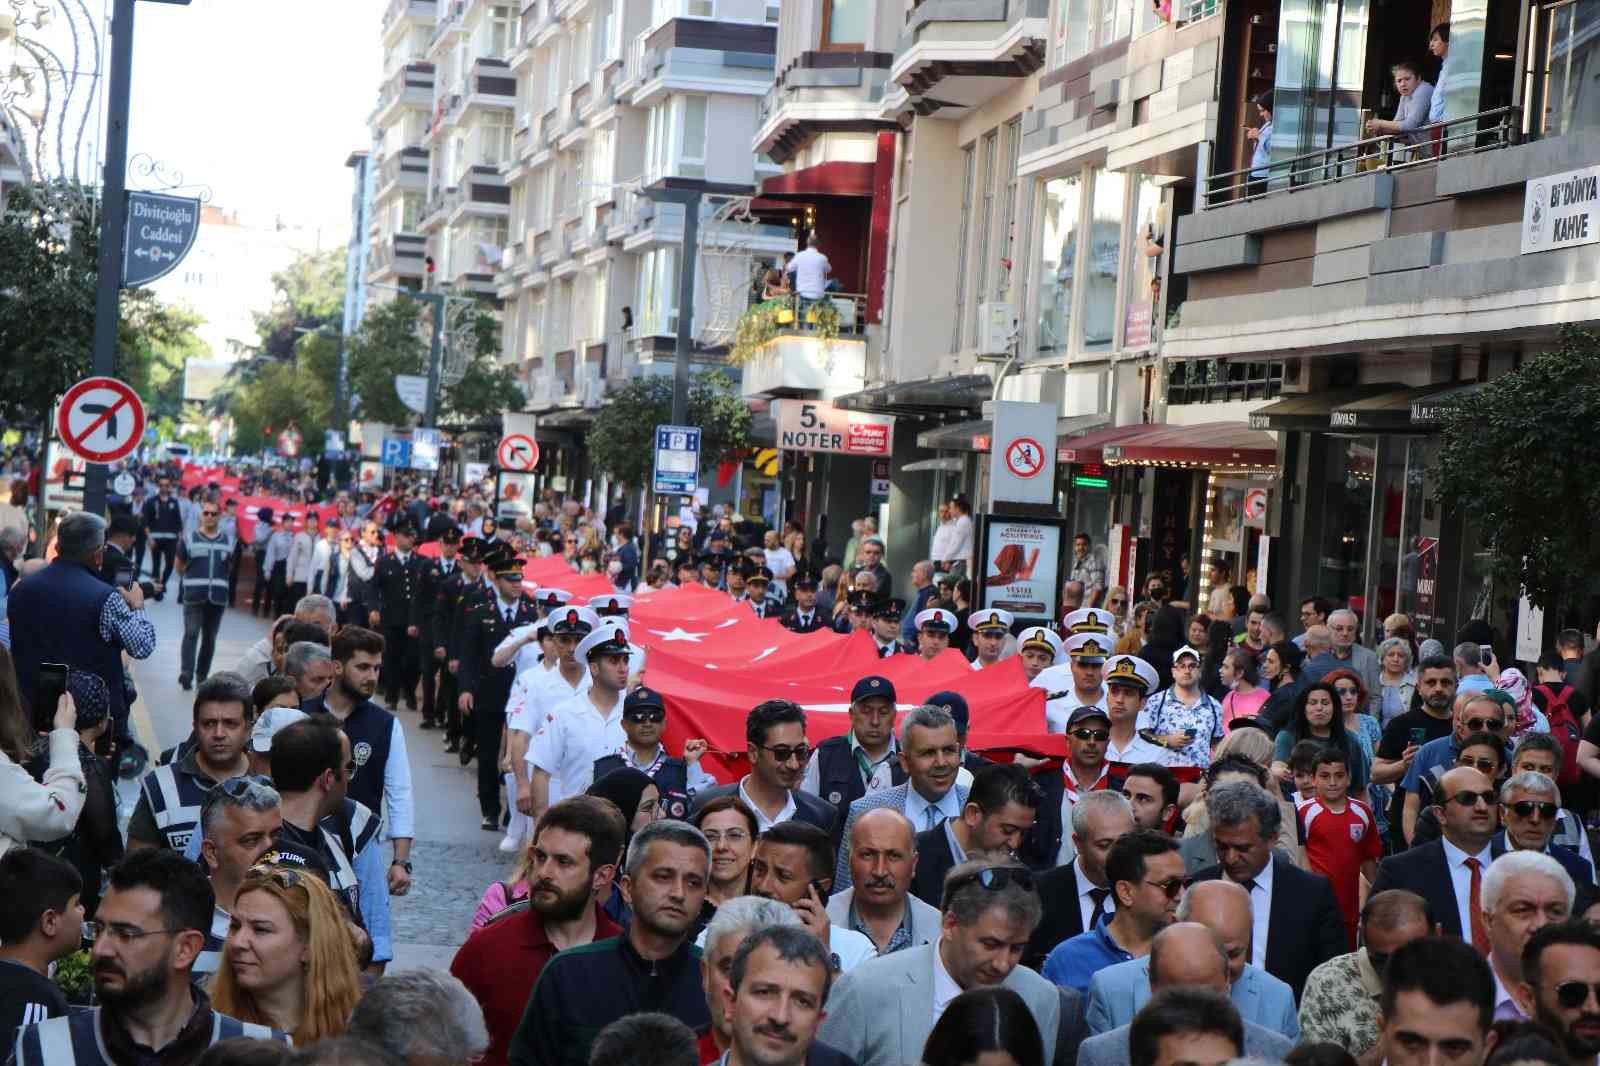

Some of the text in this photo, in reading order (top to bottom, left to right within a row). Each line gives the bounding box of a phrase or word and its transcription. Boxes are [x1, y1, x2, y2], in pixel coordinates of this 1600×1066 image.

[134, 202, 192, 226] Divitçioğlu
[1553, 213, 1589, 242] KAHVE
[800, 404, 826, 429] 5.
[783, 432, 842, 449] NOTER
